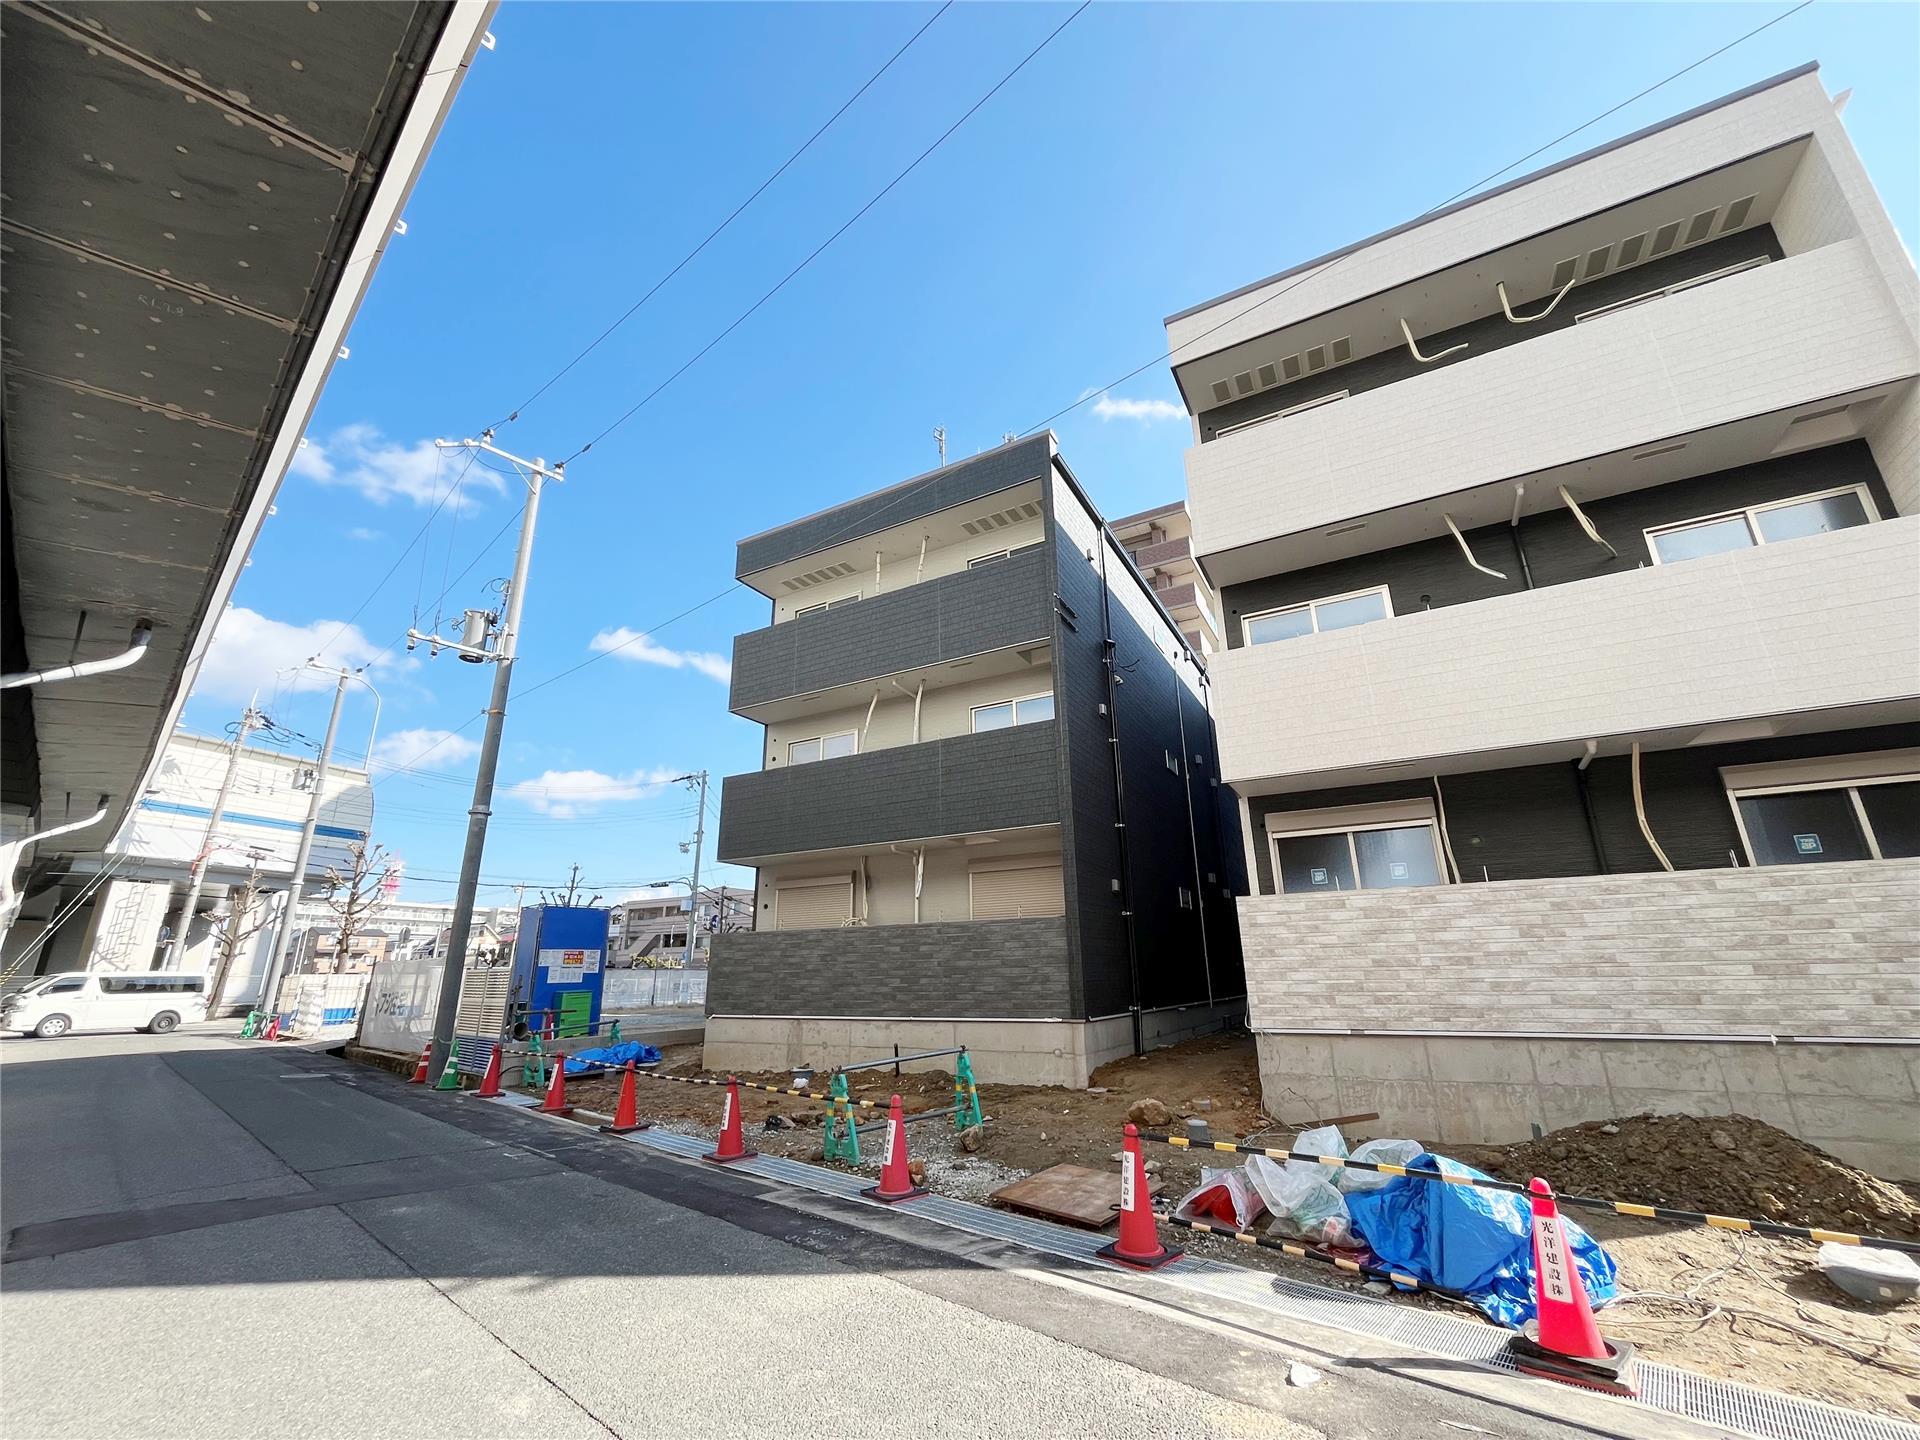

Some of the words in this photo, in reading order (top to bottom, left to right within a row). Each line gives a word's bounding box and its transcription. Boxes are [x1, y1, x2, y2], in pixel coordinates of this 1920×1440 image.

[1541, 1220, 1564, 1296] 光洋建設株
